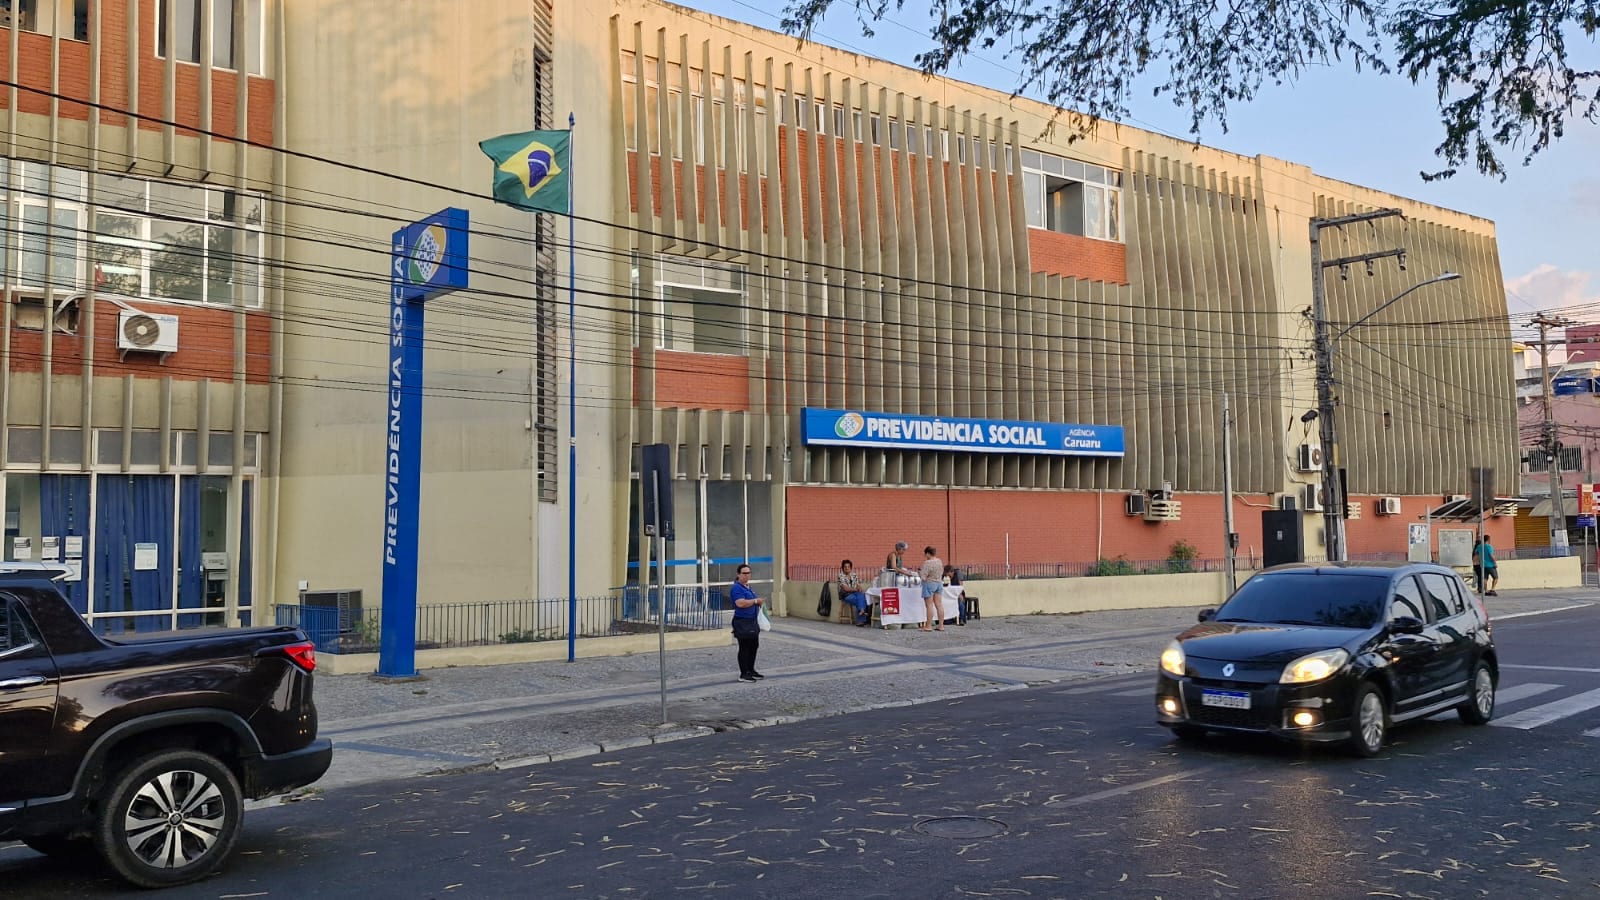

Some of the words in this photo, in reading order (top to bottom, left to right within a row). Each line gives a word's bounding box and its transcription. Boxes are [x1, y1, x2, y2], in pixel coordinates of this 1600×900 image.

[392, 235, 405, 348] SOCIAL
[386, 356, 402, 565] PREVIDÊNCIA
[867, 418, 984, 443] PREVIDÊNCIA
[988, 425, 1047, 446] SOCIAL
[1064, 437, 1101, 449] Caruaru
